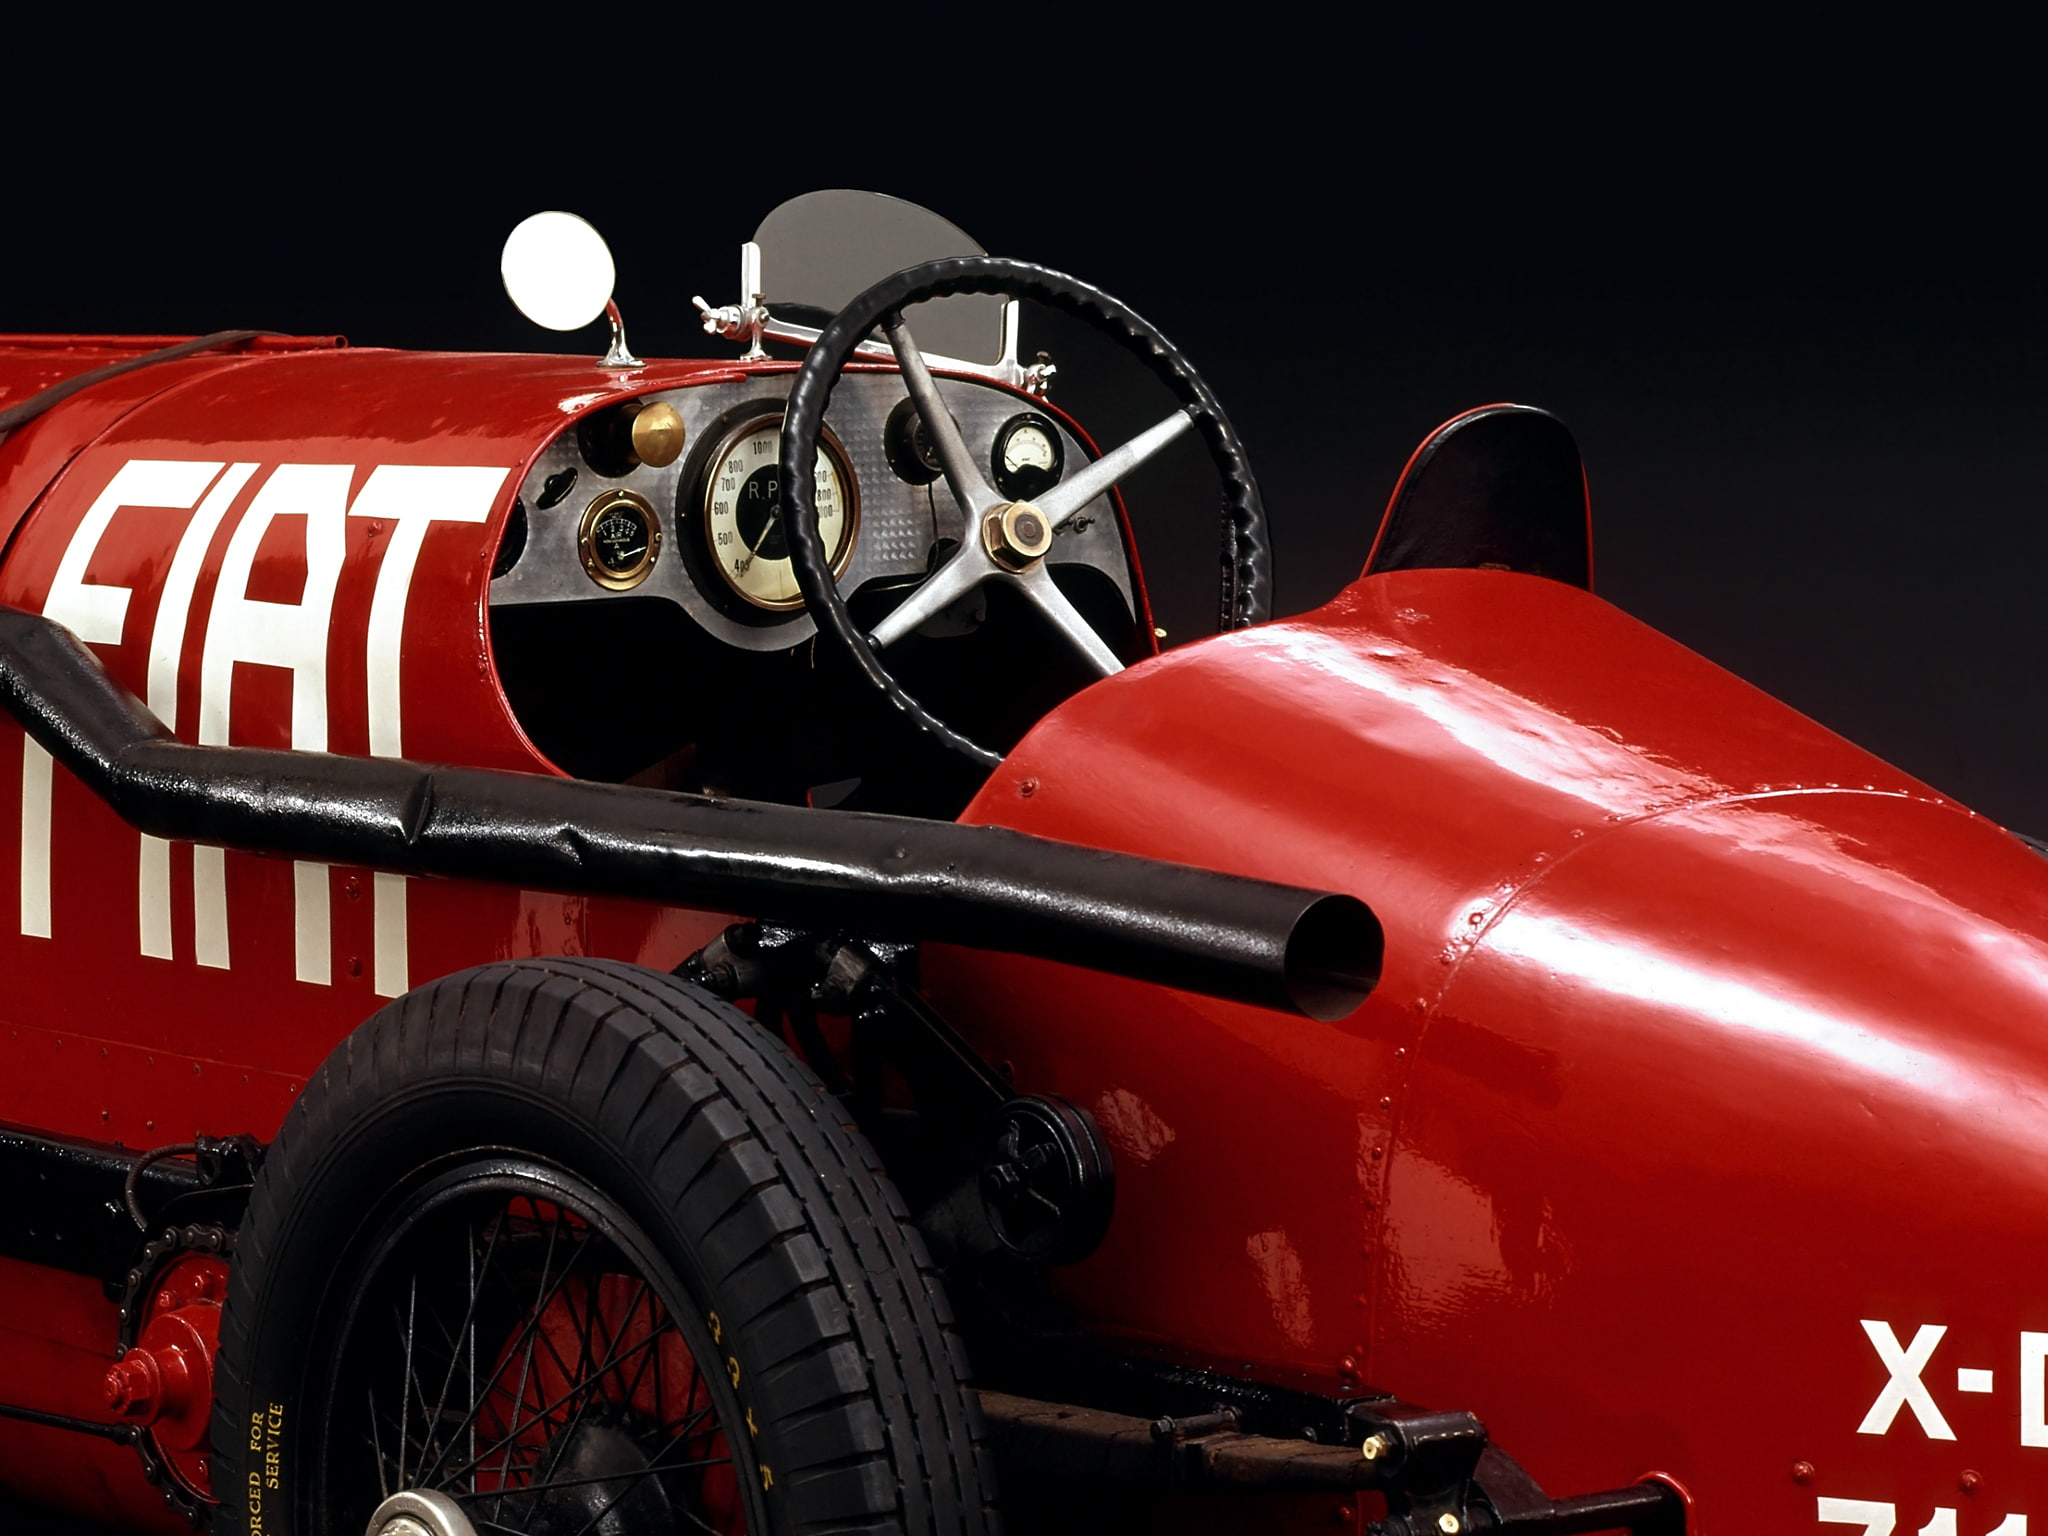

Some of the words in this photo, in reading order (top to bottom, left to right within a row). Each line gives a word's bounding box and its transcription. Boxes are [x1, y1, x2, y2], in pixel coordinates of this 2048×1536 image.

[753, 441, 773, 456] 1000
[728, 459, 744, 474] 800
[721, 477, 736, 492] 700
[749, 480, 778, 500] R.P
[714, 501, 729, 515] 600
[717, 531, 733, 546] 500
[20, 459, 511, 999] FIAT
[250, 1412, 264, 1452] FOR
[266, 1402, 284, 1489] SERVICE
